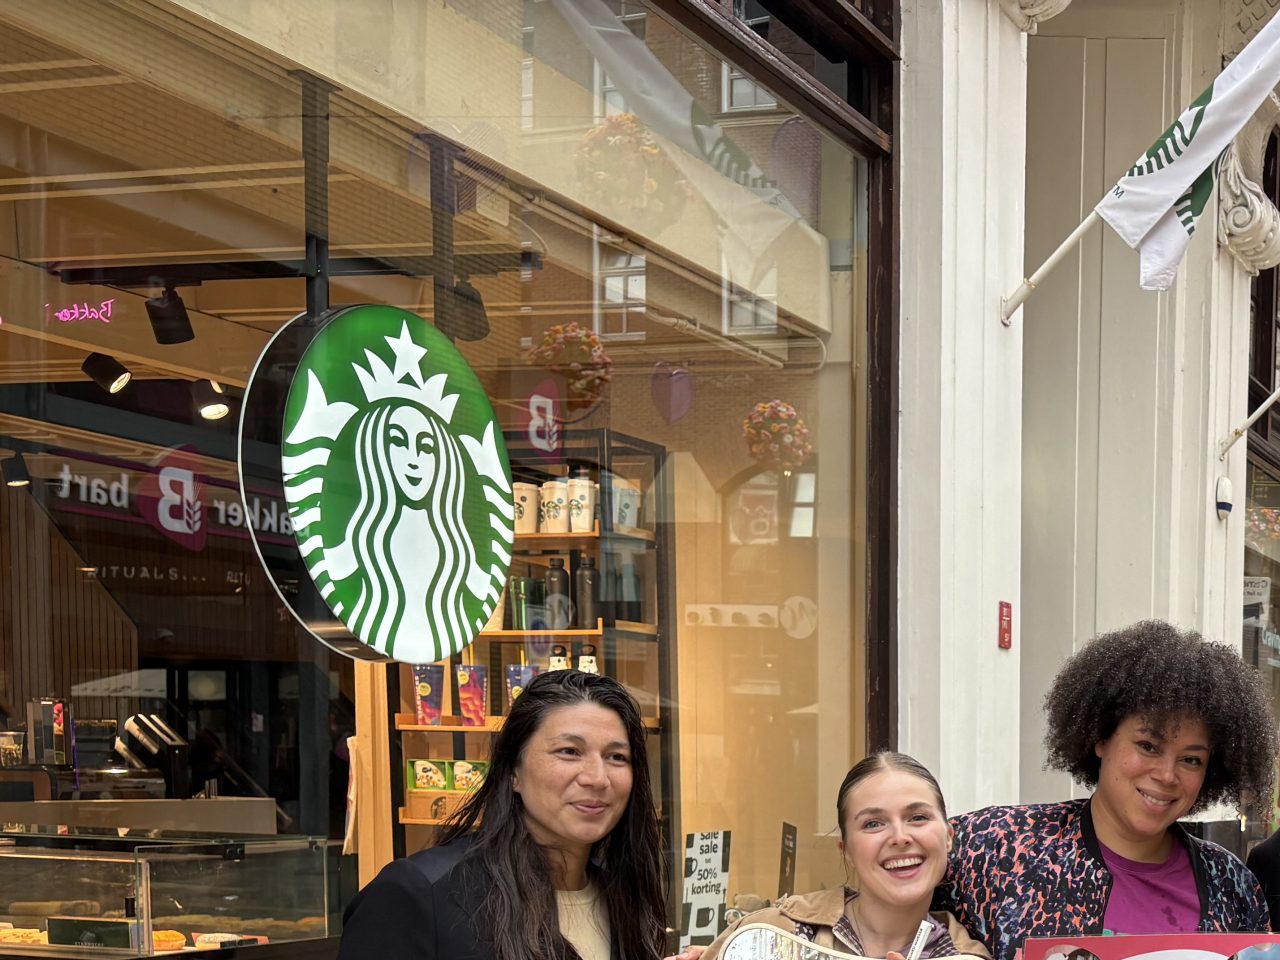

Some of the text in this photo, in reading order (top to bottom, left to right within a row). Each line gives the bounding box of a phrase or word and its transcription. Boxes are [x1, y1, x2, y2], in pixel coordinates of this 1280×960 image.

[699, 841, 718, 855] sale
[697, 867, 718, 881] 50%
[691, 882, 722, 895] korting
